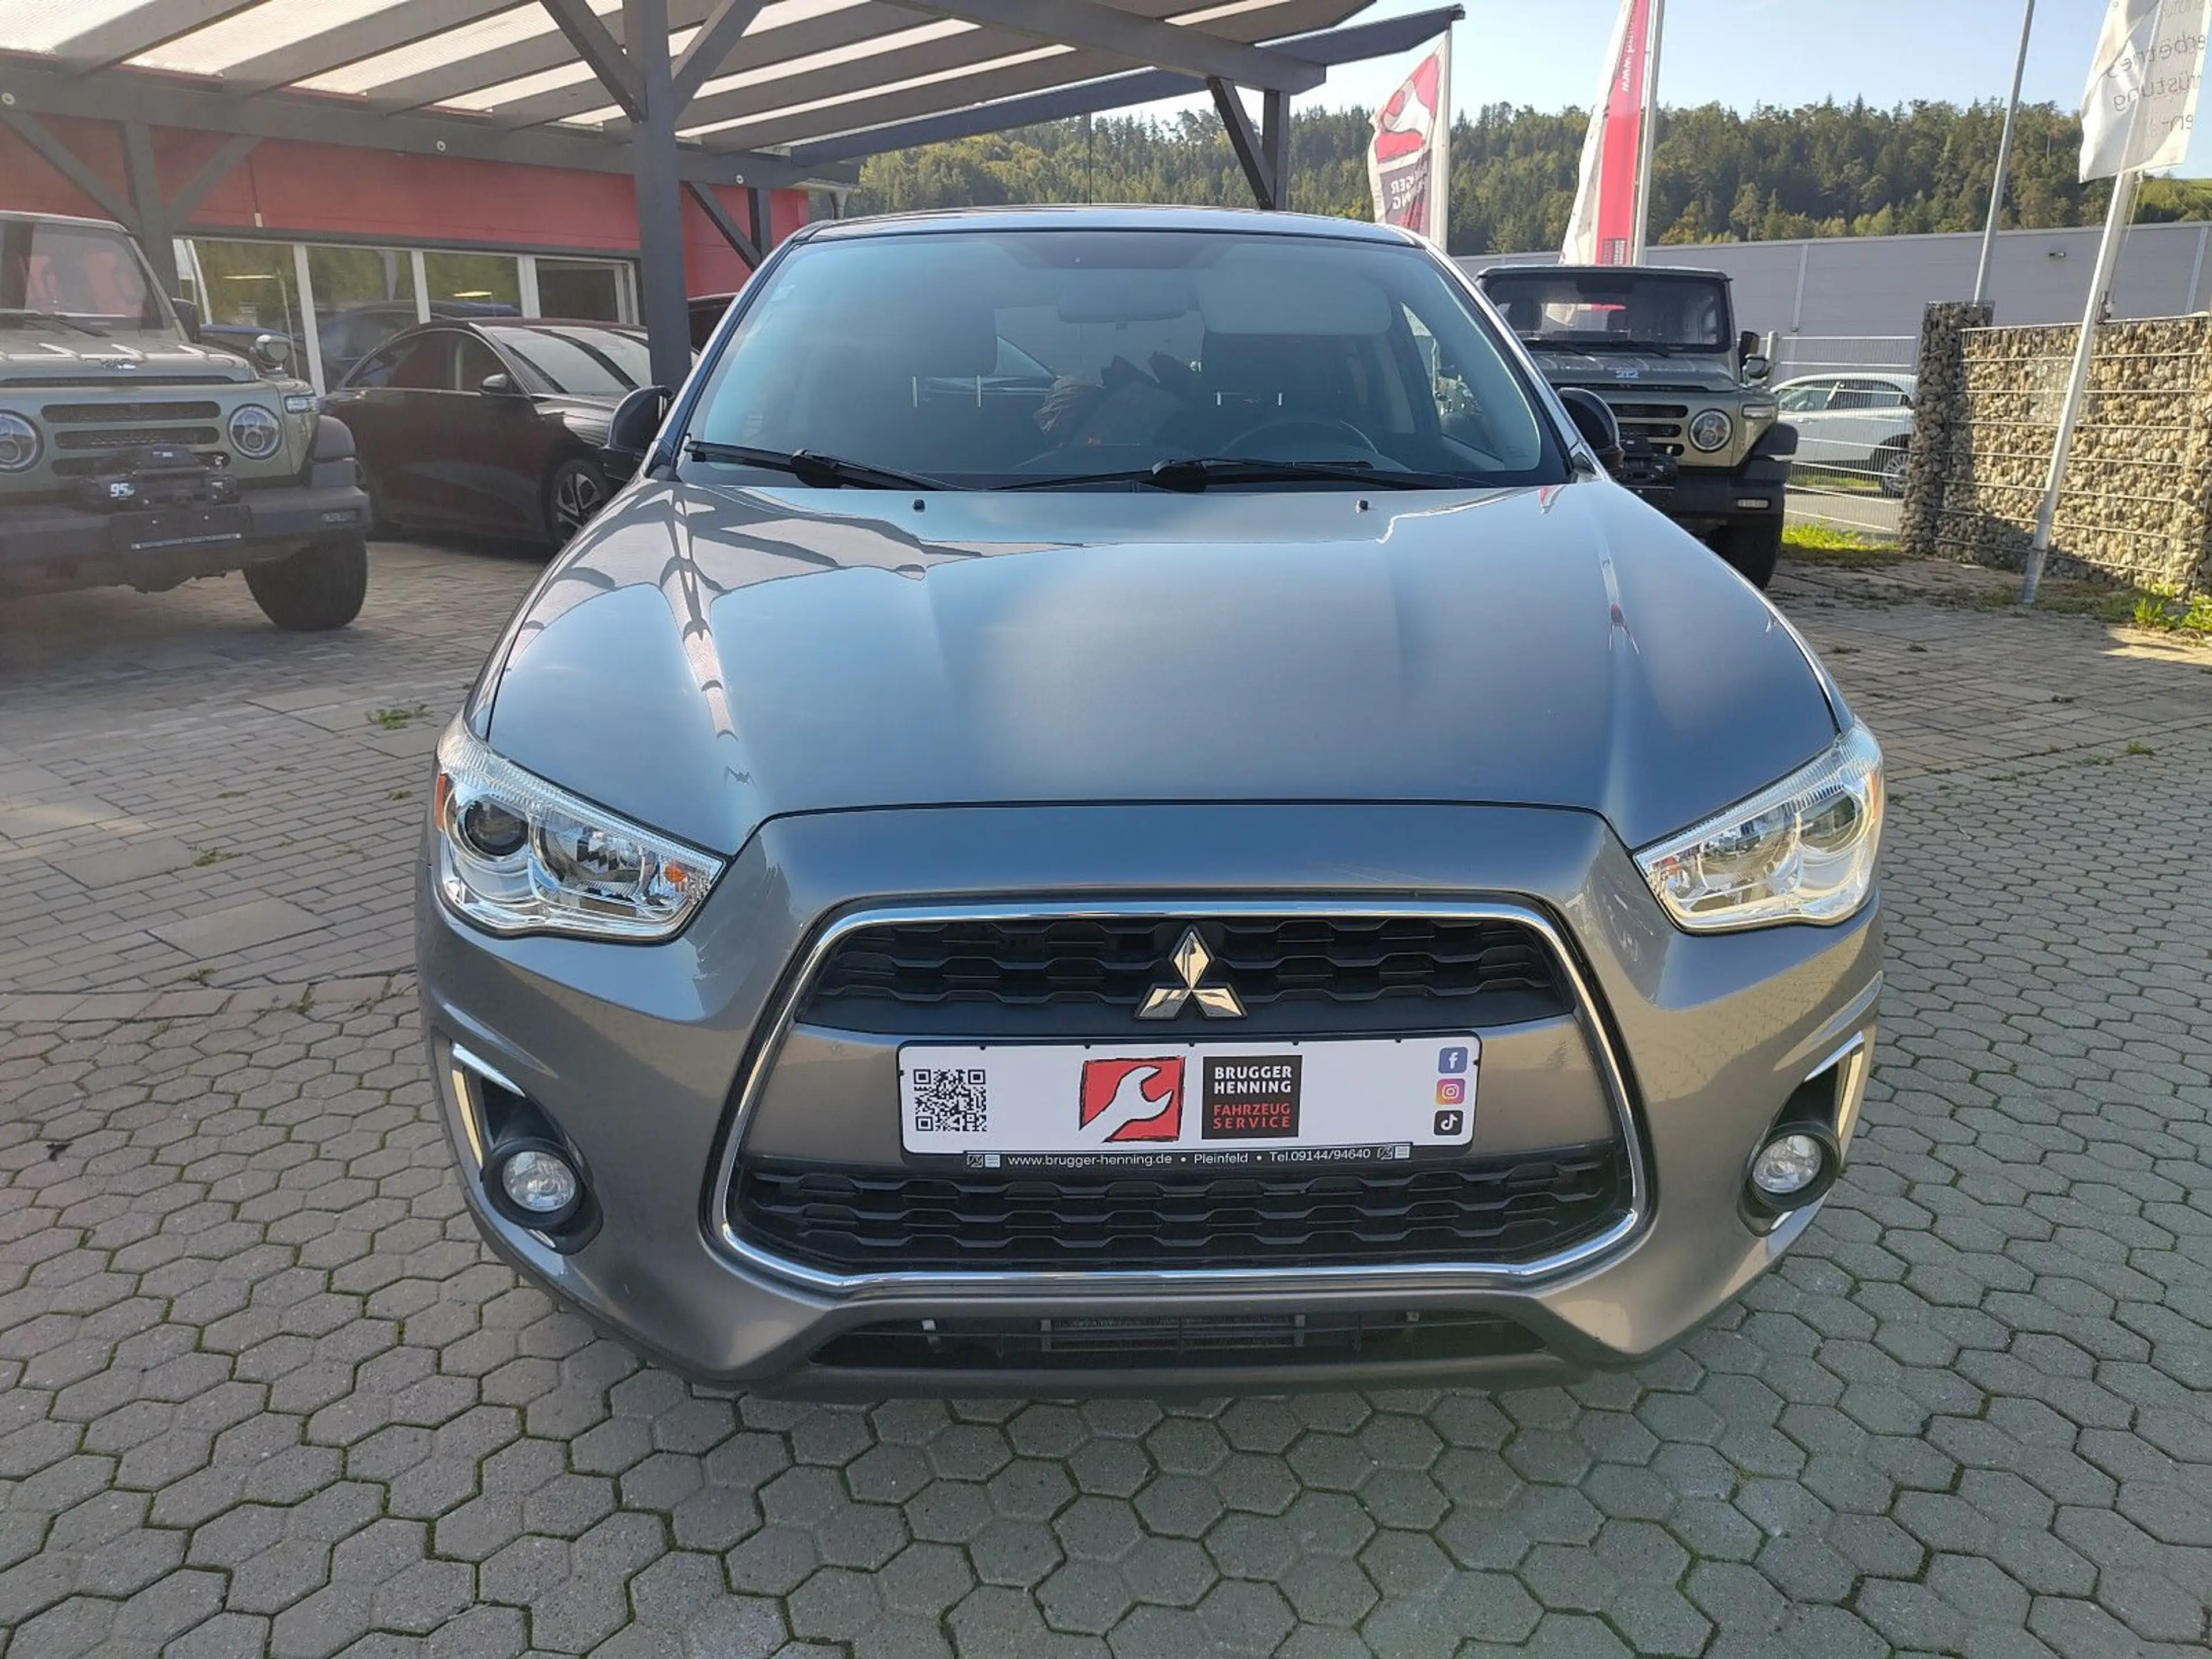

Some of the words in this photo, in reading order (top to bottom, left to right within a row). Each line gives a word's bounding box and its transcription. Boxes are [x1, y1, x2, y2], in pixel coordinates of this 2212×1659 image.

[1214, 1066, 1293, 1080] BRUGGER
[1214, 1080, 1291, 1094] HENNING
[1213, 1103, 1291, 1116] FAHRZEUG
[1213, 1116, 1291, 1130] SERVICE
[1007, 1154, 1172, 1168] www.brugger-henning.de
[1194, 1152, 1249, 1164] Pleinfeld
[1270, 1149, 1372, 1162] Tel.09144/94640
